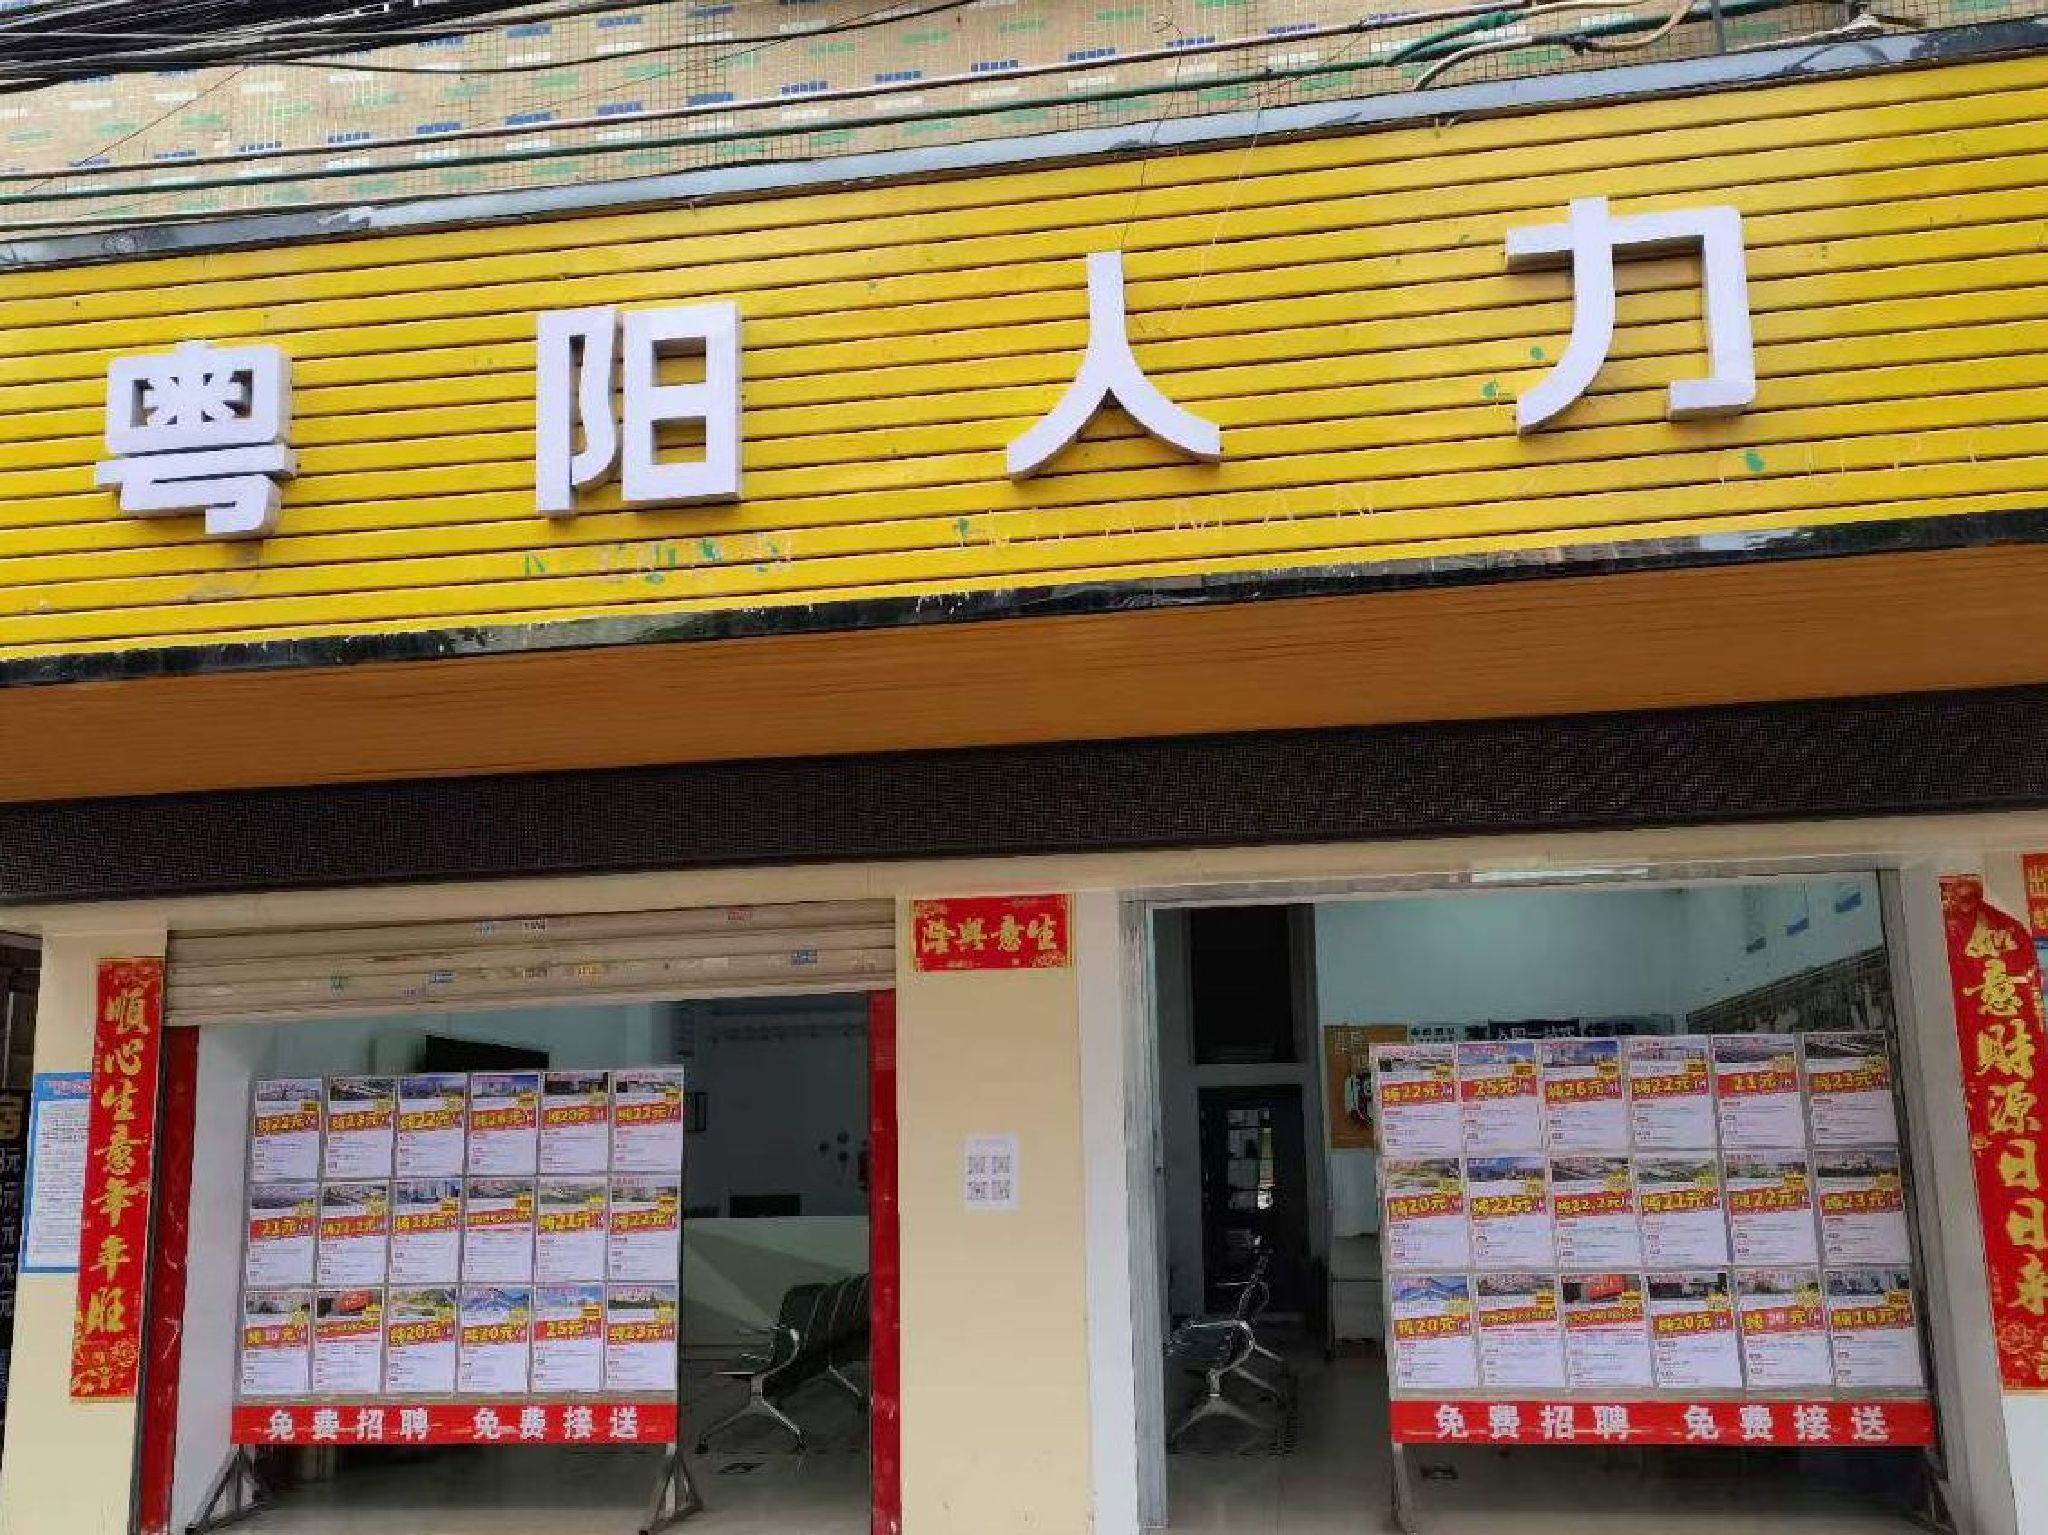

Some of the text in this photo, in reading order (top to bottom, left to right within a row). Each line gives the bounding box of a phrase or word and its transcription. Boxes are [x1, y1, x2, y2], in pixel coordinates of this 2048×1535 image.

[95, 198, 1756, 534] 粤阳人力
[267, 1406, 639, 1440] 免费招聘 免费接送
[1435, 1404, 1889, 1440] 免费招聘 免费接送
